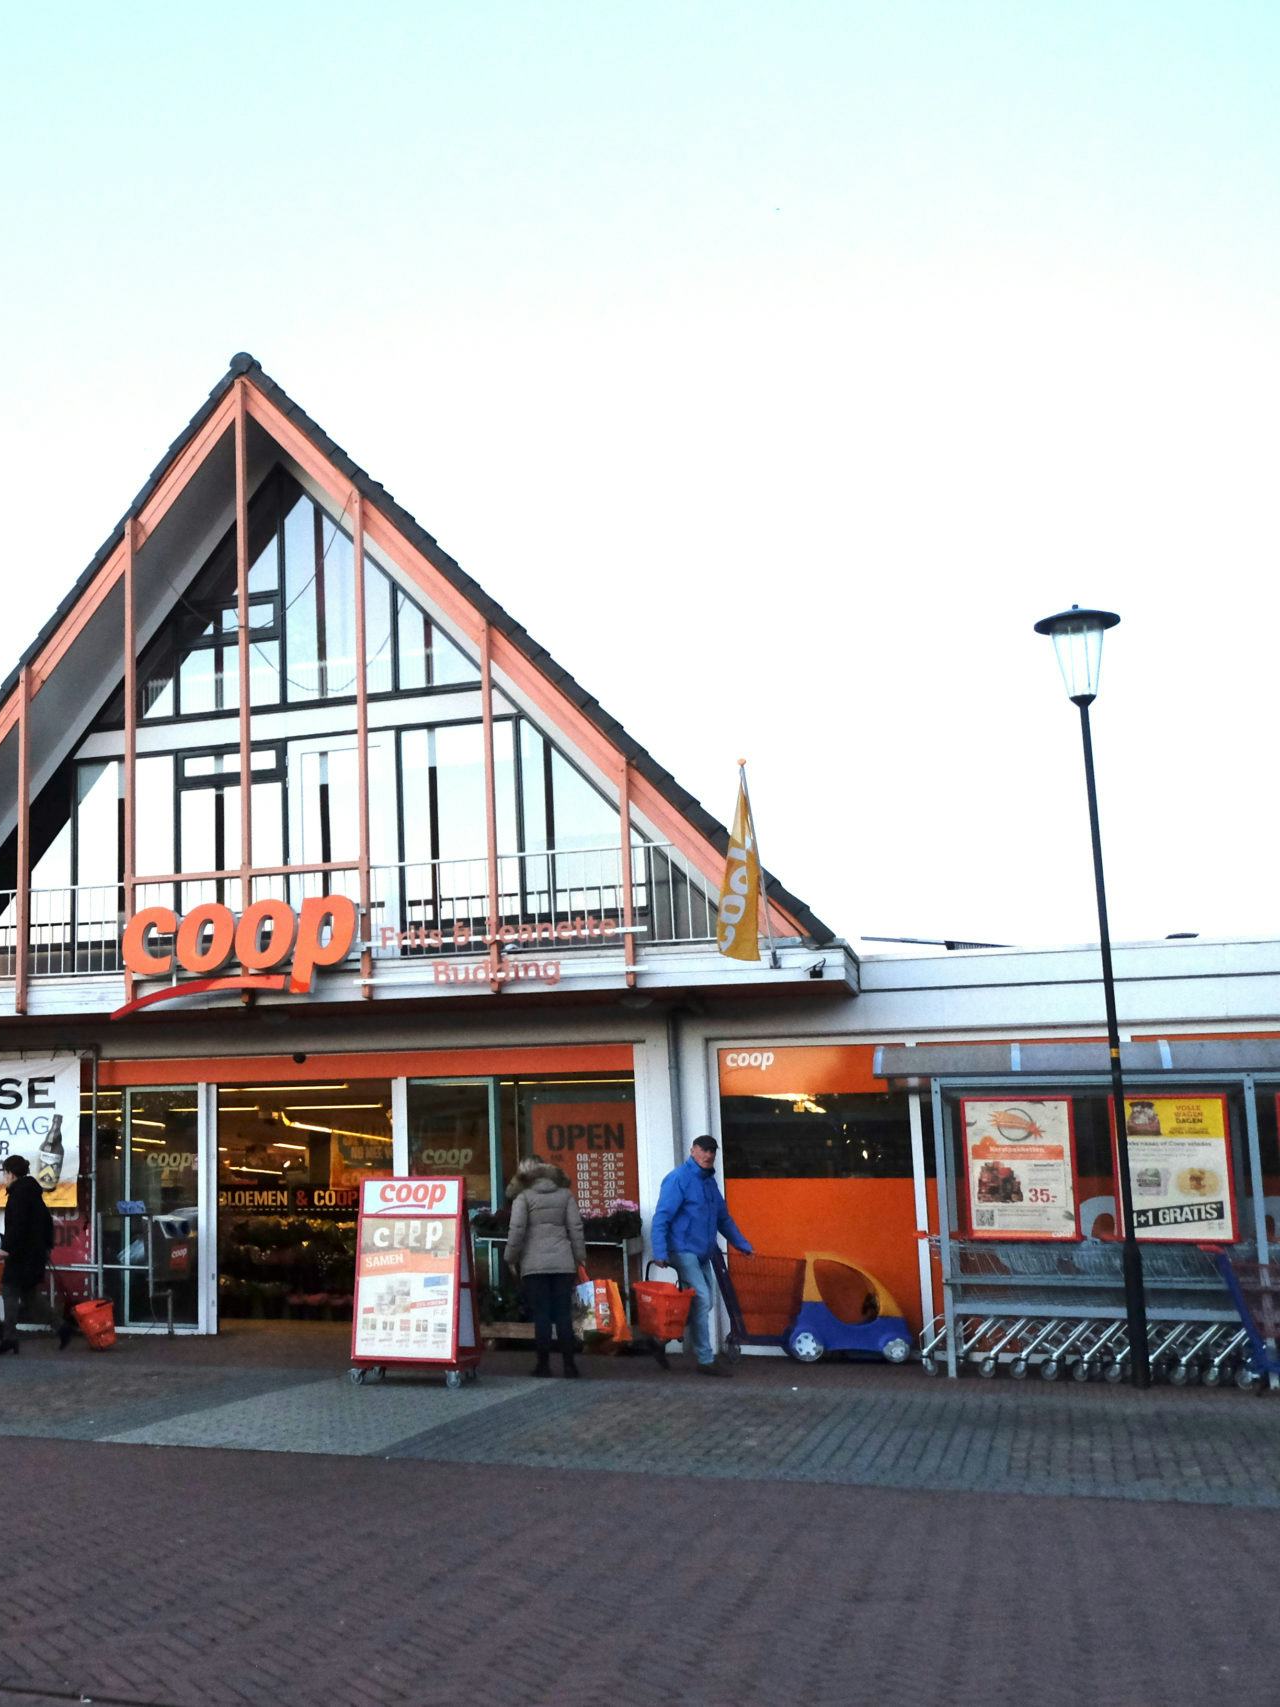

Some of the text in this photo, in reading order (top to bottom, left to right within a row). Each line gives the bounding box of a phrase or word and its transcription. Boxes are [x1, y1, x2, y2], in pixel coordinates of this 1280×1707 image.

[121, 894, 356, 995] coop
[379, 925, 443, 950] Frits
[481, 915, 617, 946] Jeanette
[431, 959, 561, 986] Budding
[726, 1051, 775, 1070] coop
[546, 1122, 625, 1151] OPEN
[147, 1152, 191, 1172] coop
[422, 1149, 473, 1169] coop
[219, 1190, 288, 1206] BLOEMEN
[313, 1190, 358, 1206] COOP
[379, 1183, 446, 1210] coop
[1158, 1203, 1218, 1225] GRATIS
